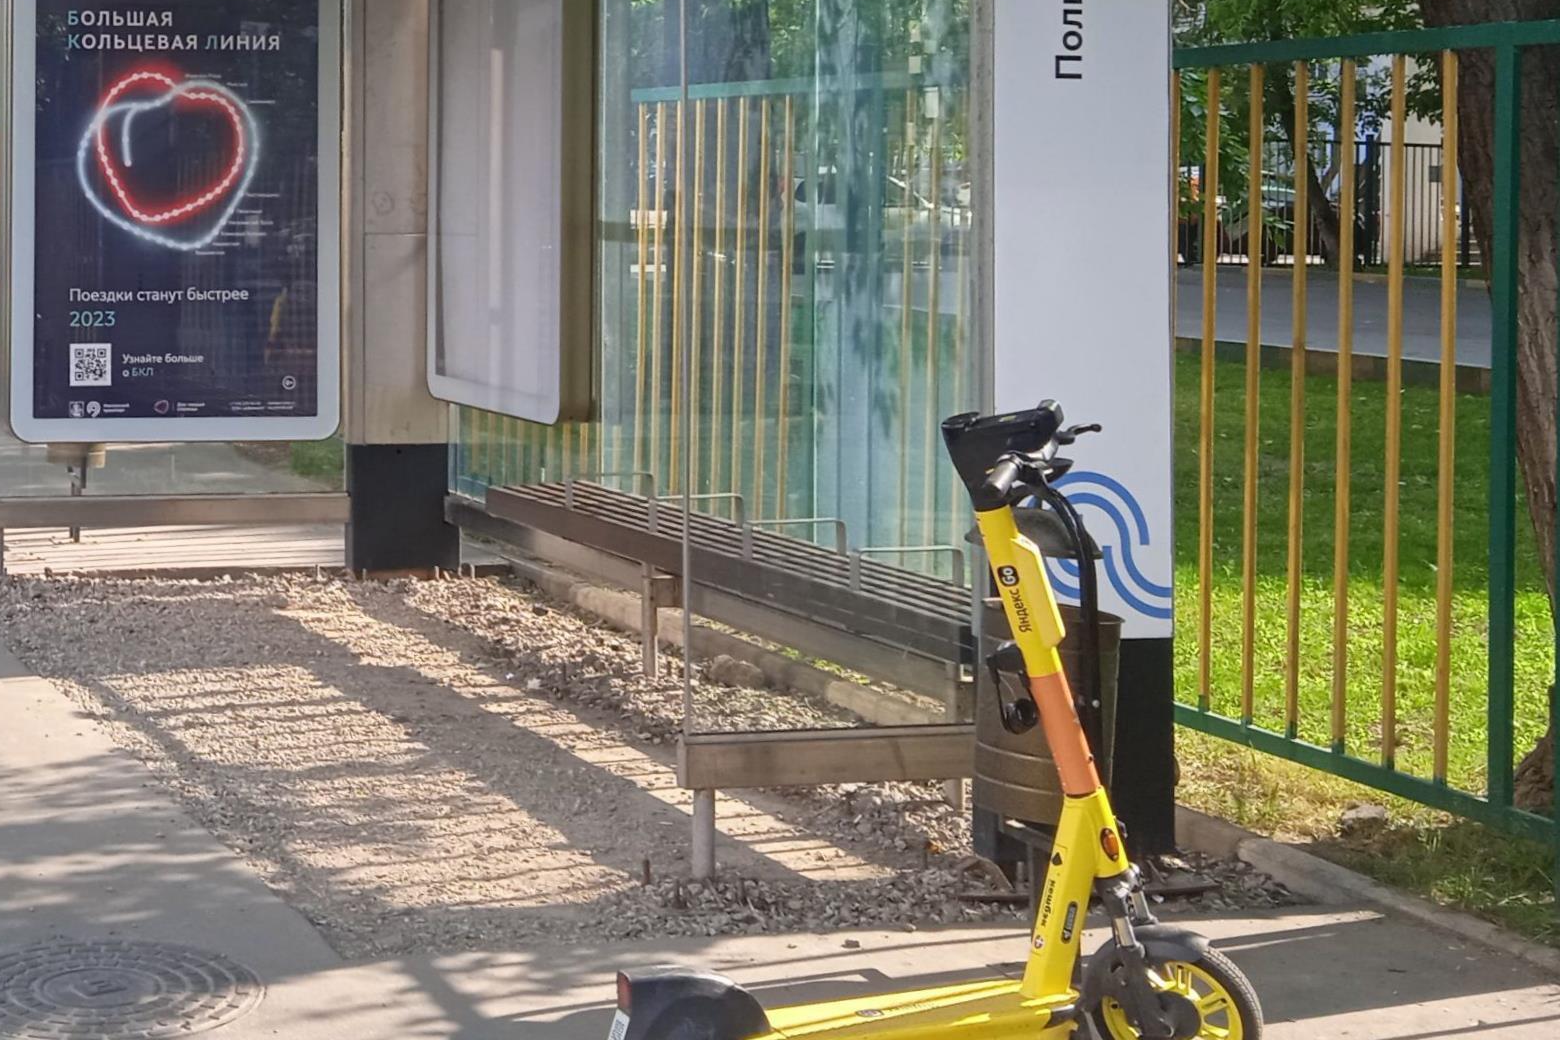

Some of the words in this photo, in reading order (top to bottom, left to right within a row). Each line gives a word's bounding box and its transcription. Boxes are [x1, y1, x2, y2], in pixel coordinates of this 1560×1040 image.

[67, 10, 173, 27] БОЛЬШАЯ
[67, 34, 198, 51] КОЛЬЦЕВАЯ
[205, 34, 280, 50] ЛИНИЯ
[69, 288, 133, 303] Поездки
[136, 289, 184, 304] станут
[186, 287, 249, 303] быстрее
[69, 311, 116, 327] 2023
[122, 353, 163, 365] Узнайте
[164, 353, 204, 364] больше
[131, 367, 154, 377] БКЛ
[1002, 568, 1017, 586] Go
[1009, 588, 1033, 633] Яндекс
